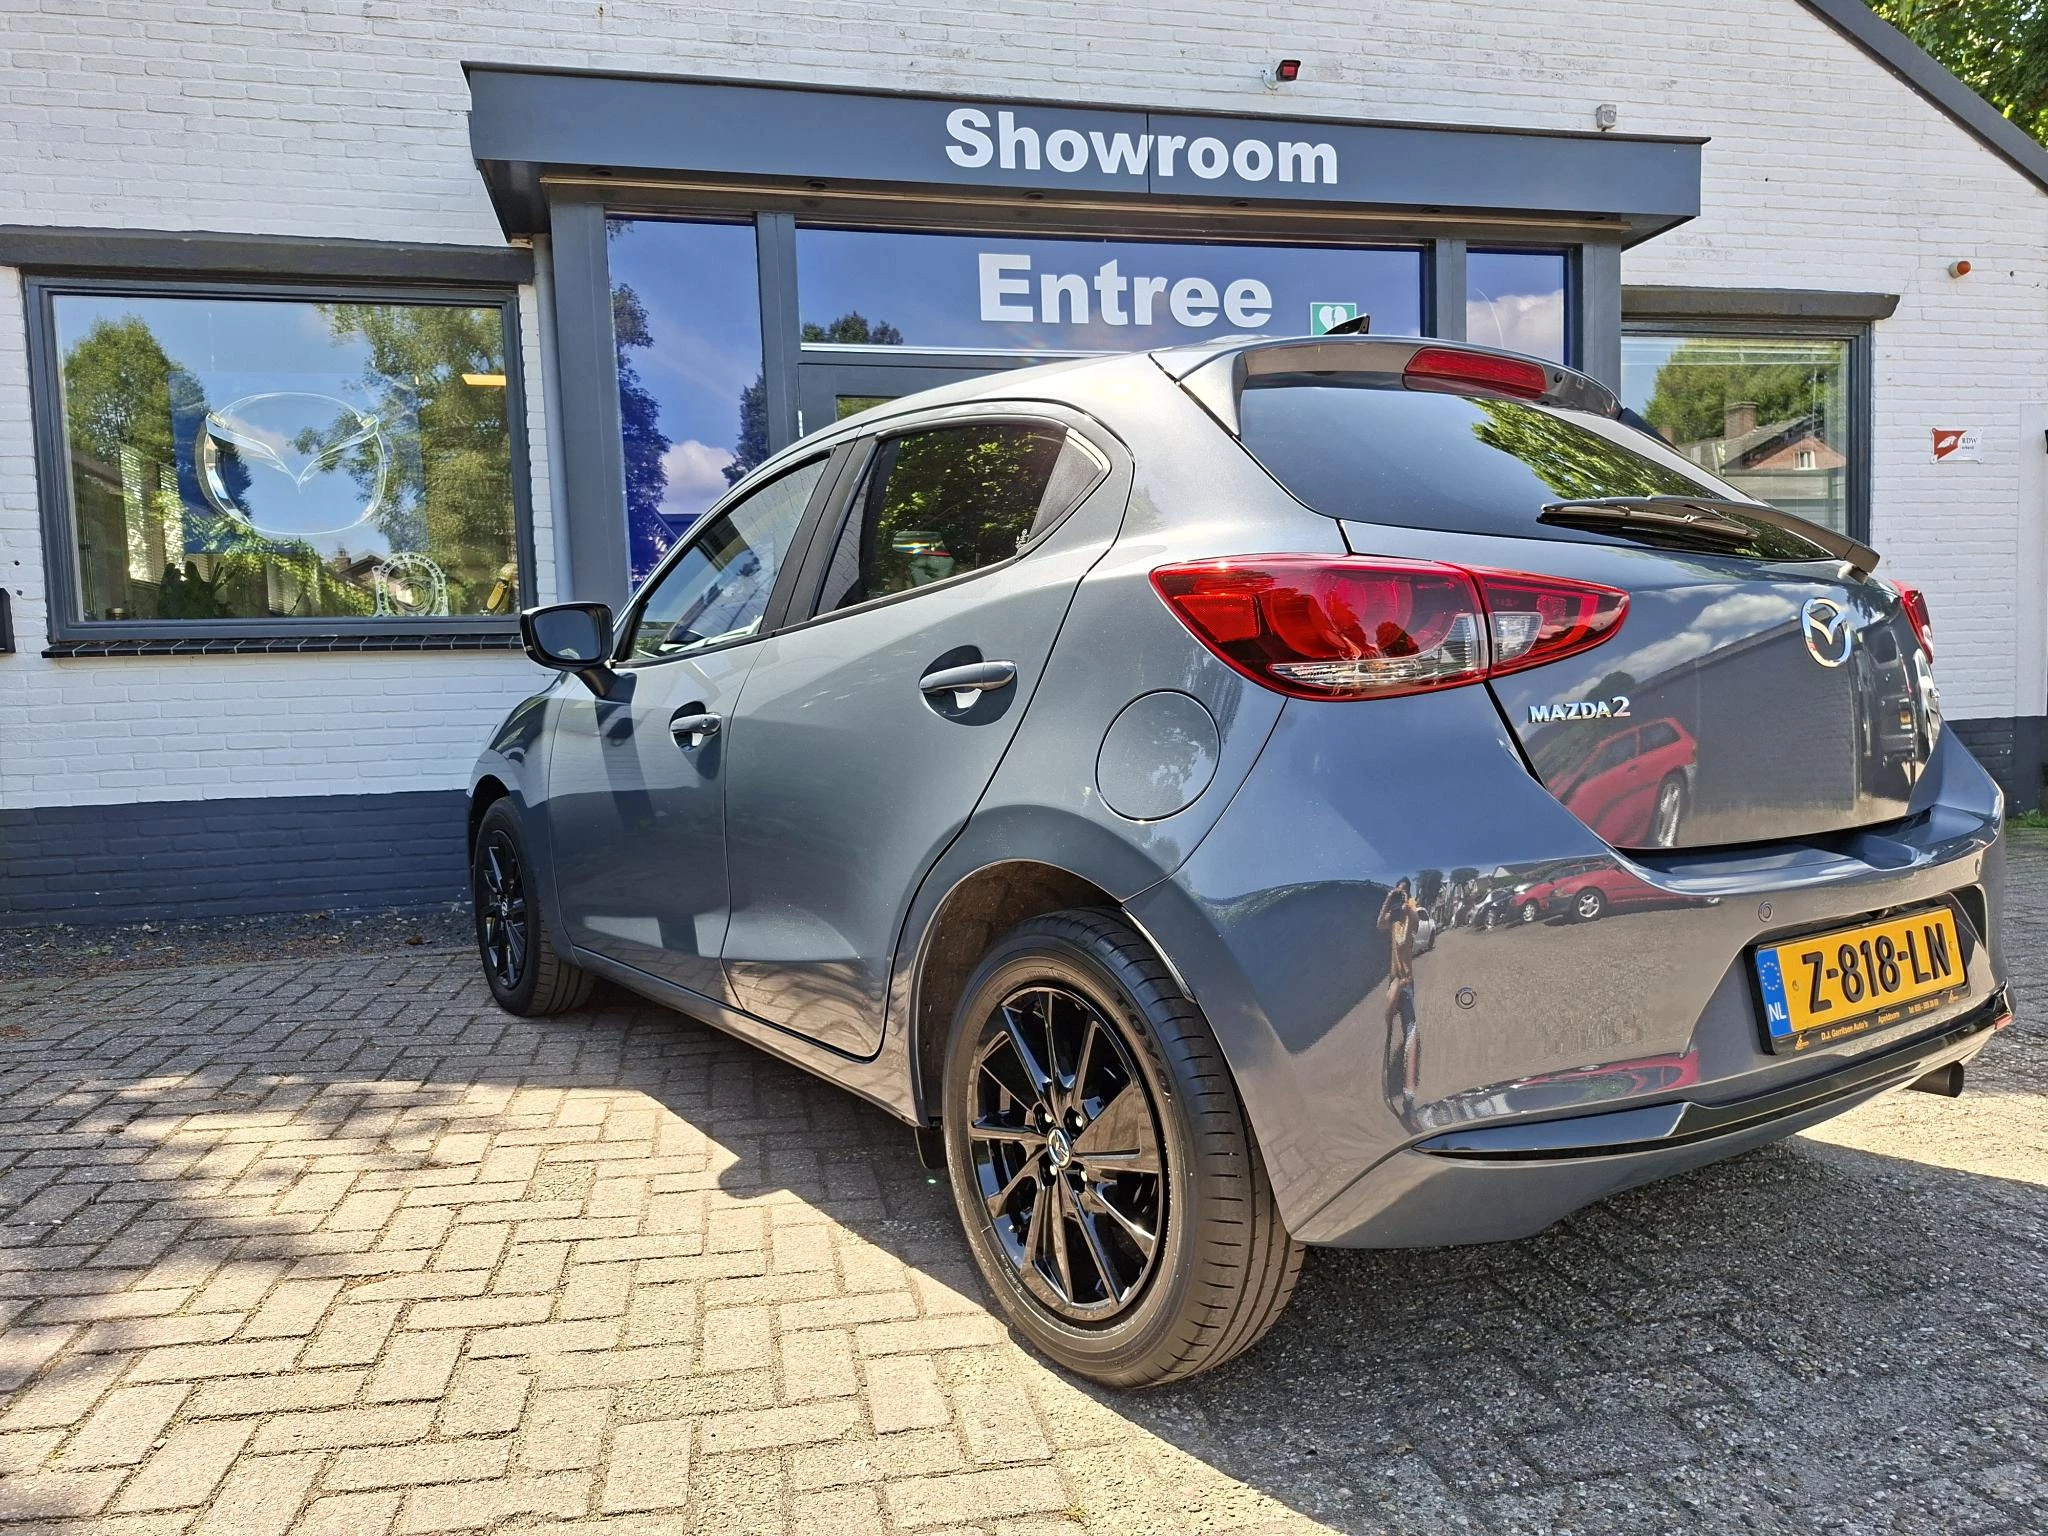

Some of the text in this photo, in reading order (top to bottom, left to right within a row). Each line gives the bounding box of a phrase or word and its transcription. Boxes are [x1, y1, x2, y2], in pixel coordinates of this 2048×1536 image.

[945, 107, 1338, 184] Showroom
[978, 252, 1273, 328] Entree
[1528, 696, 1631, 723] MAZDA2
[1801, 923, 1952, 1014] Z-818-LN
[1768, 1002, 1787, 1022] NL
[1853, 1019, 1869, 1032] Auto's
